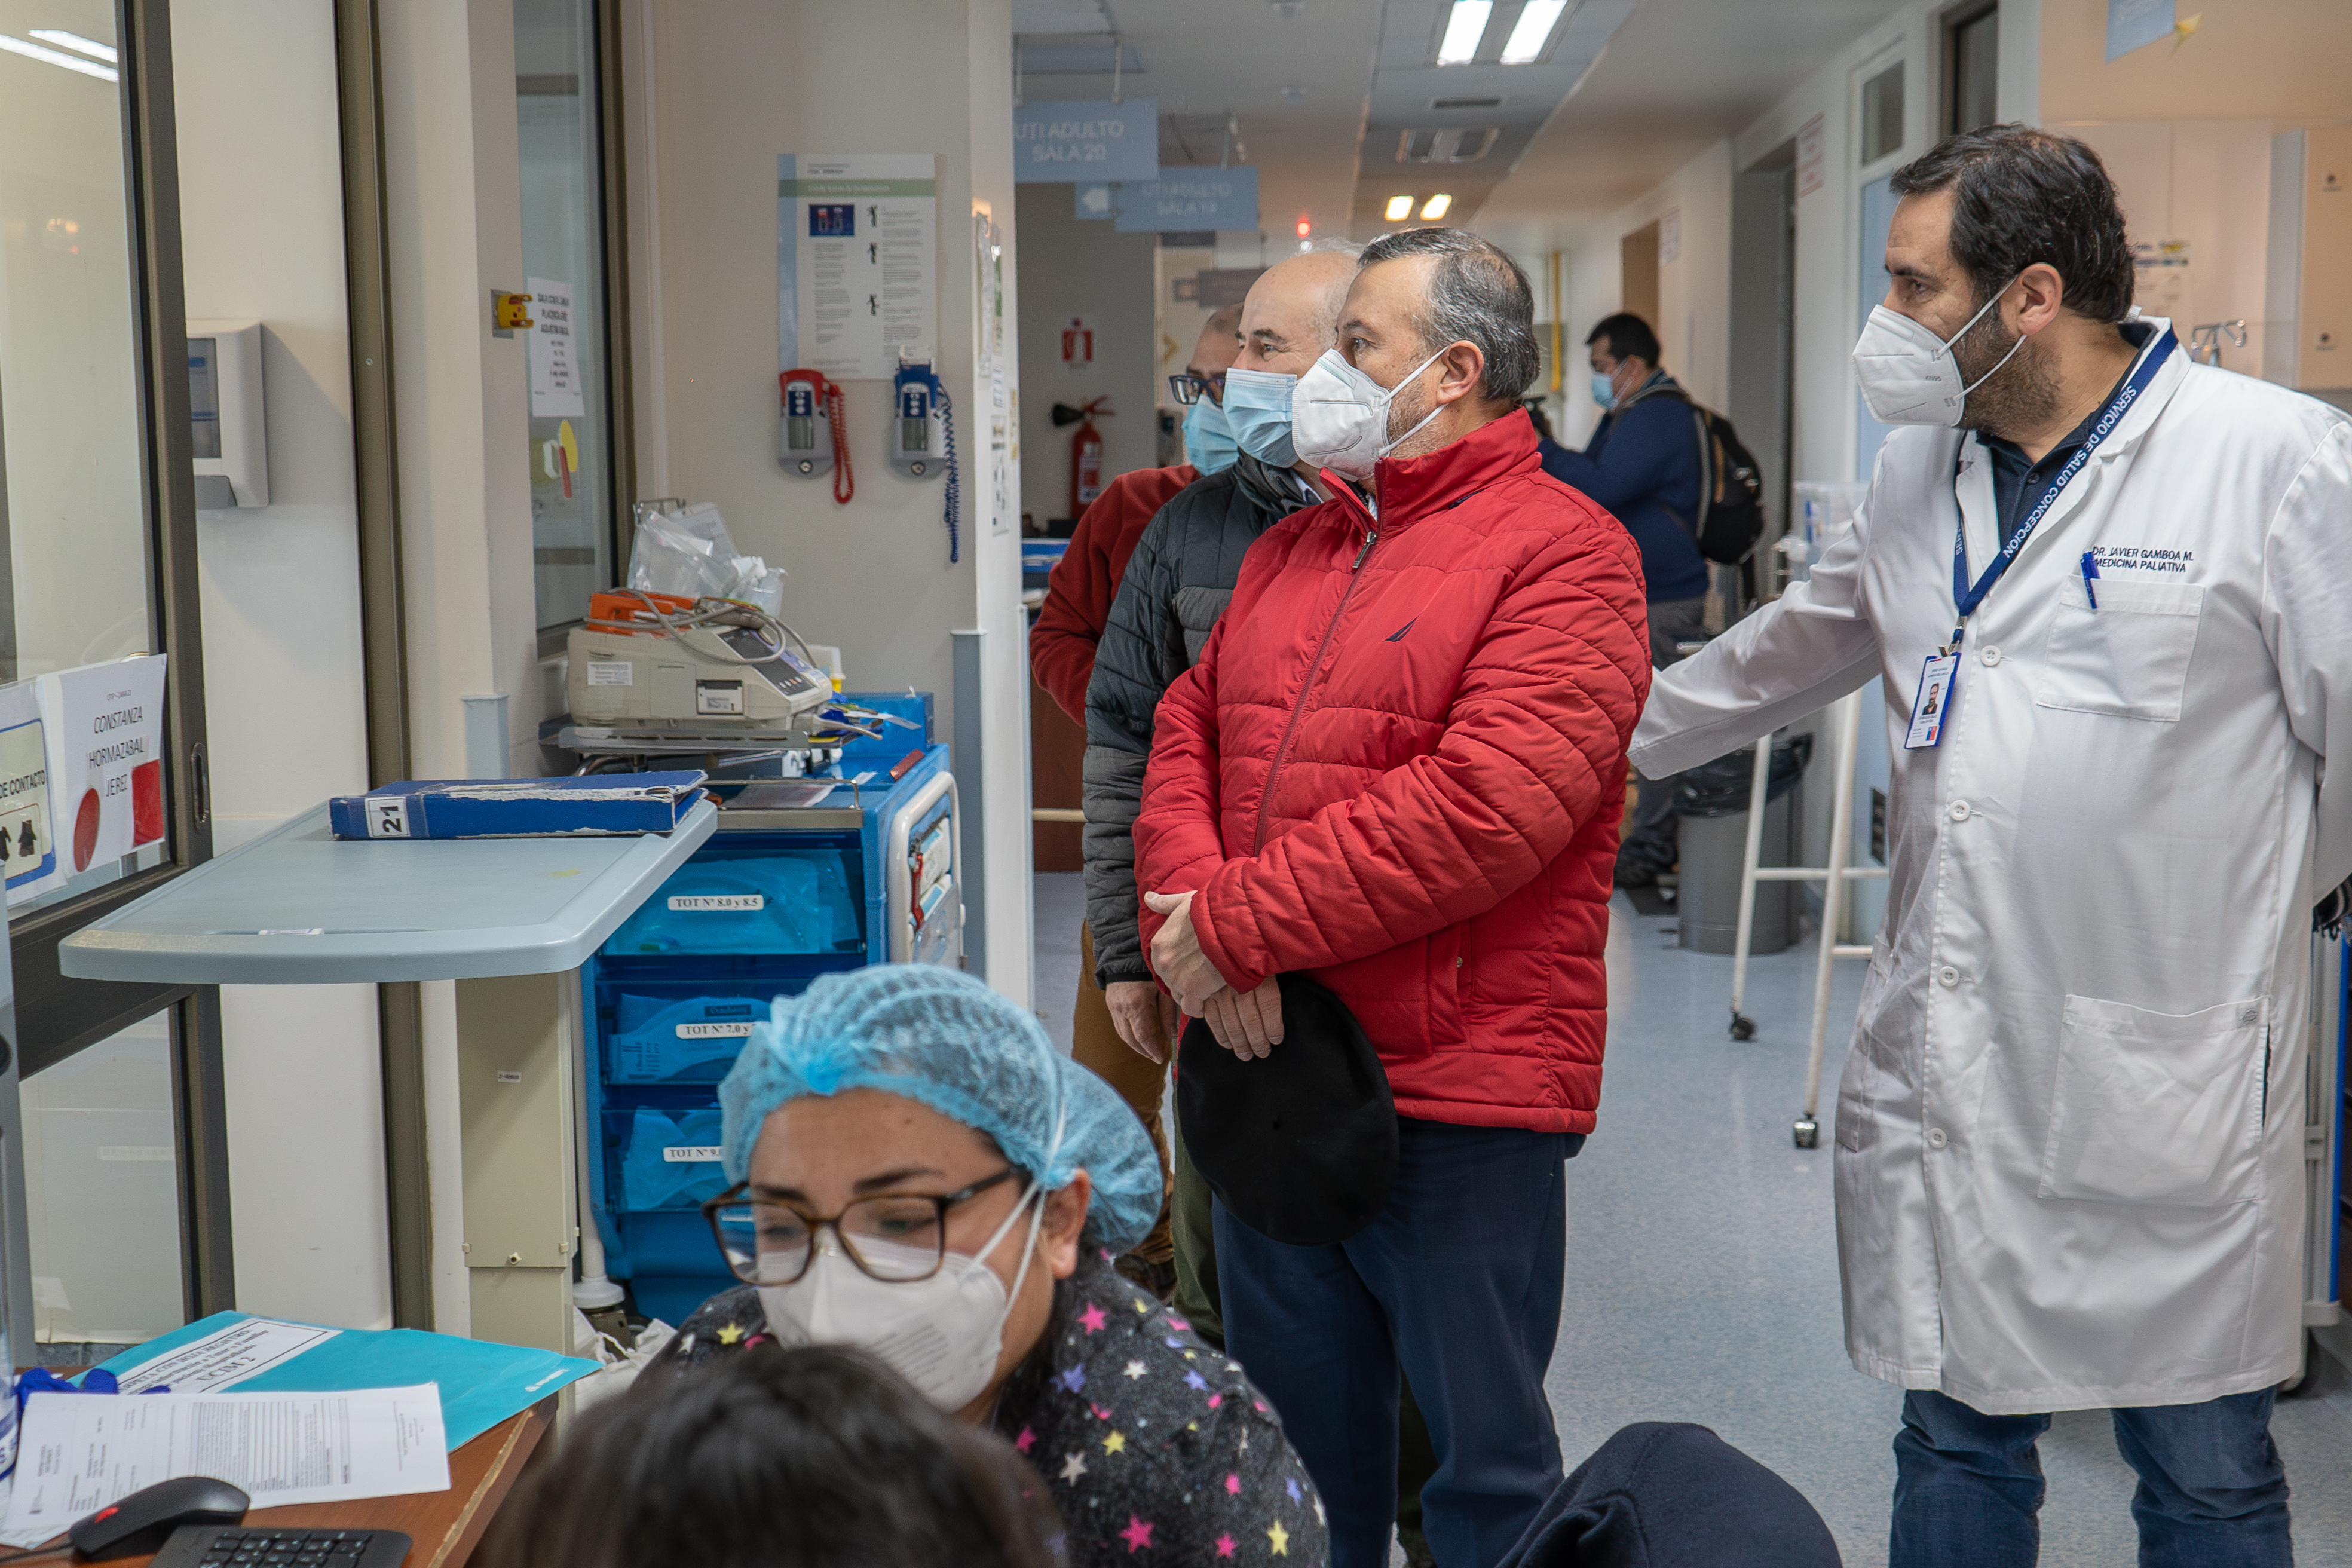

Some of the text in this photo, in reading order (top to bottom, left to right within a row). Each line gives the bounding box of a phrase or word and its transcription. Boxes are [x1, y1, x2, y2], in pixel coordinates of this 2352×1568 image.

[1014, 121, 1125, 140] UTI ADULTO
[1031, 143, 1107, 163] SALA 20
[2002, 385, 2137, 558] SERVICIO DE SALUD CONCEPCIÓN
[2108, 547, 2139, 558] JAVIER
[2141, 549, 2180, 561] GAMBOA
[2094, 558, 2186, 572] MEDICINA PALIATIVA
[94, 706, 143, 734] CONSTANZA
[89, 737, 145, 769] HORMAZABAL
[9, 769, 46, 795] CONTACTO
[106, 774, 128, 797] JEREZ
[379, 806, 402, 832] 21
[676, 898, 699, 907] TOT
[685, 1025, 708, 1035] TOT
[670, 1149, 693, 1158] TOT
